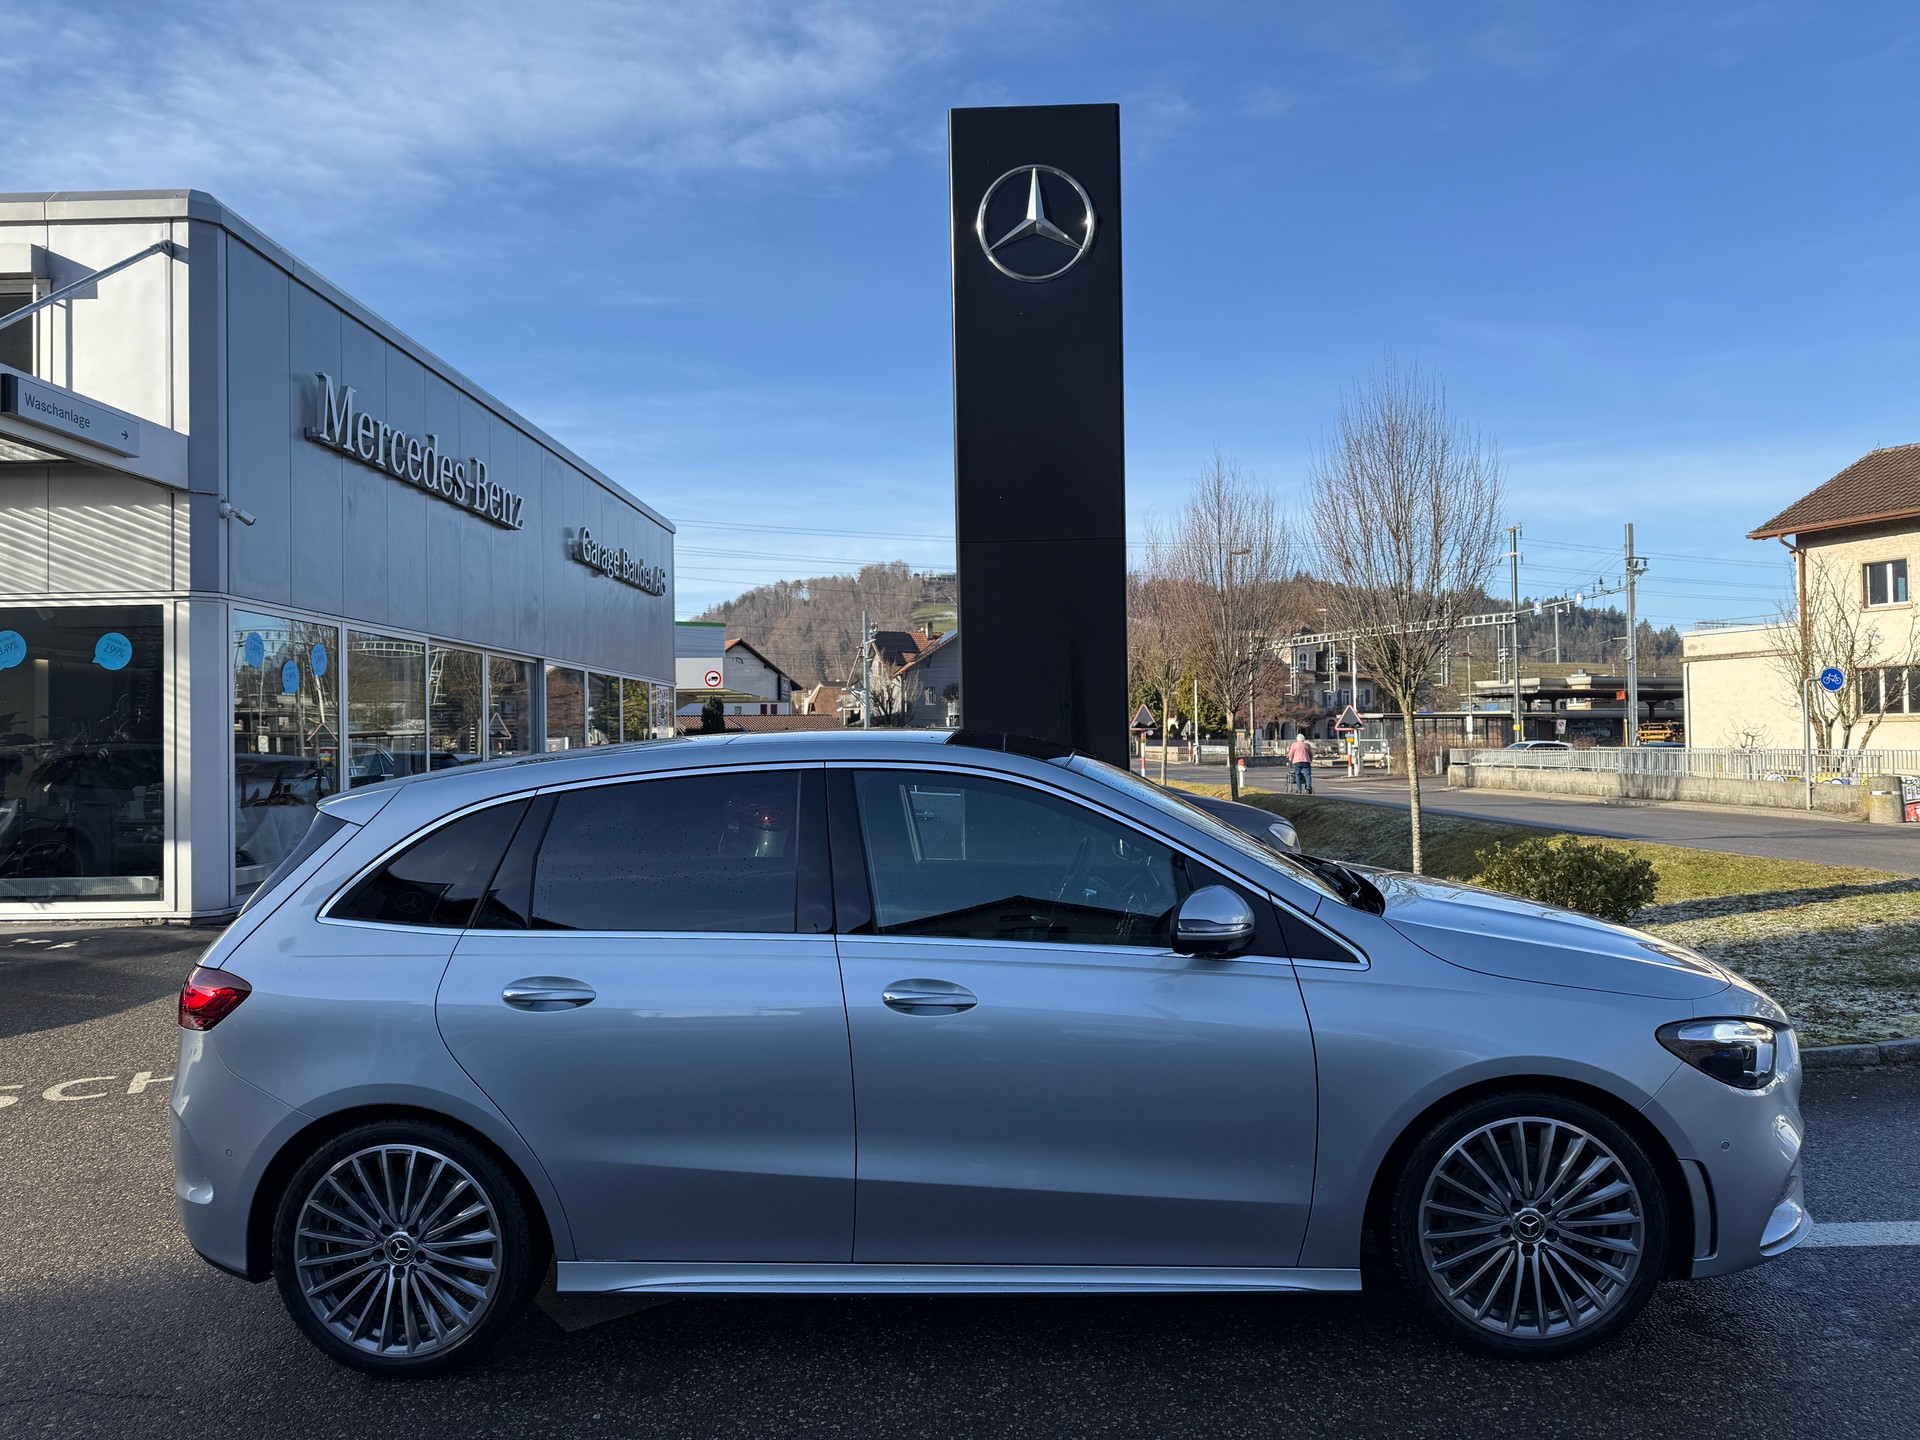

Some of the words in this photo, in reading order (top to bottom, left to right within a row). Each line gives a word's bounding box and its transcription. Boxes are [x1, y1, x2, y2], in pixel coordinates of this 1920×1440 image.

[24, 392, 90, 429] Waschanlage
[316, 372, 525, 529] Mercedes-Benz
[581, 527, 620, 578] Garage
[622, 548, 653, 591] Bauder
[654, 568, 666, 595] AG
[103, 642, 125, 659] 2.99%
